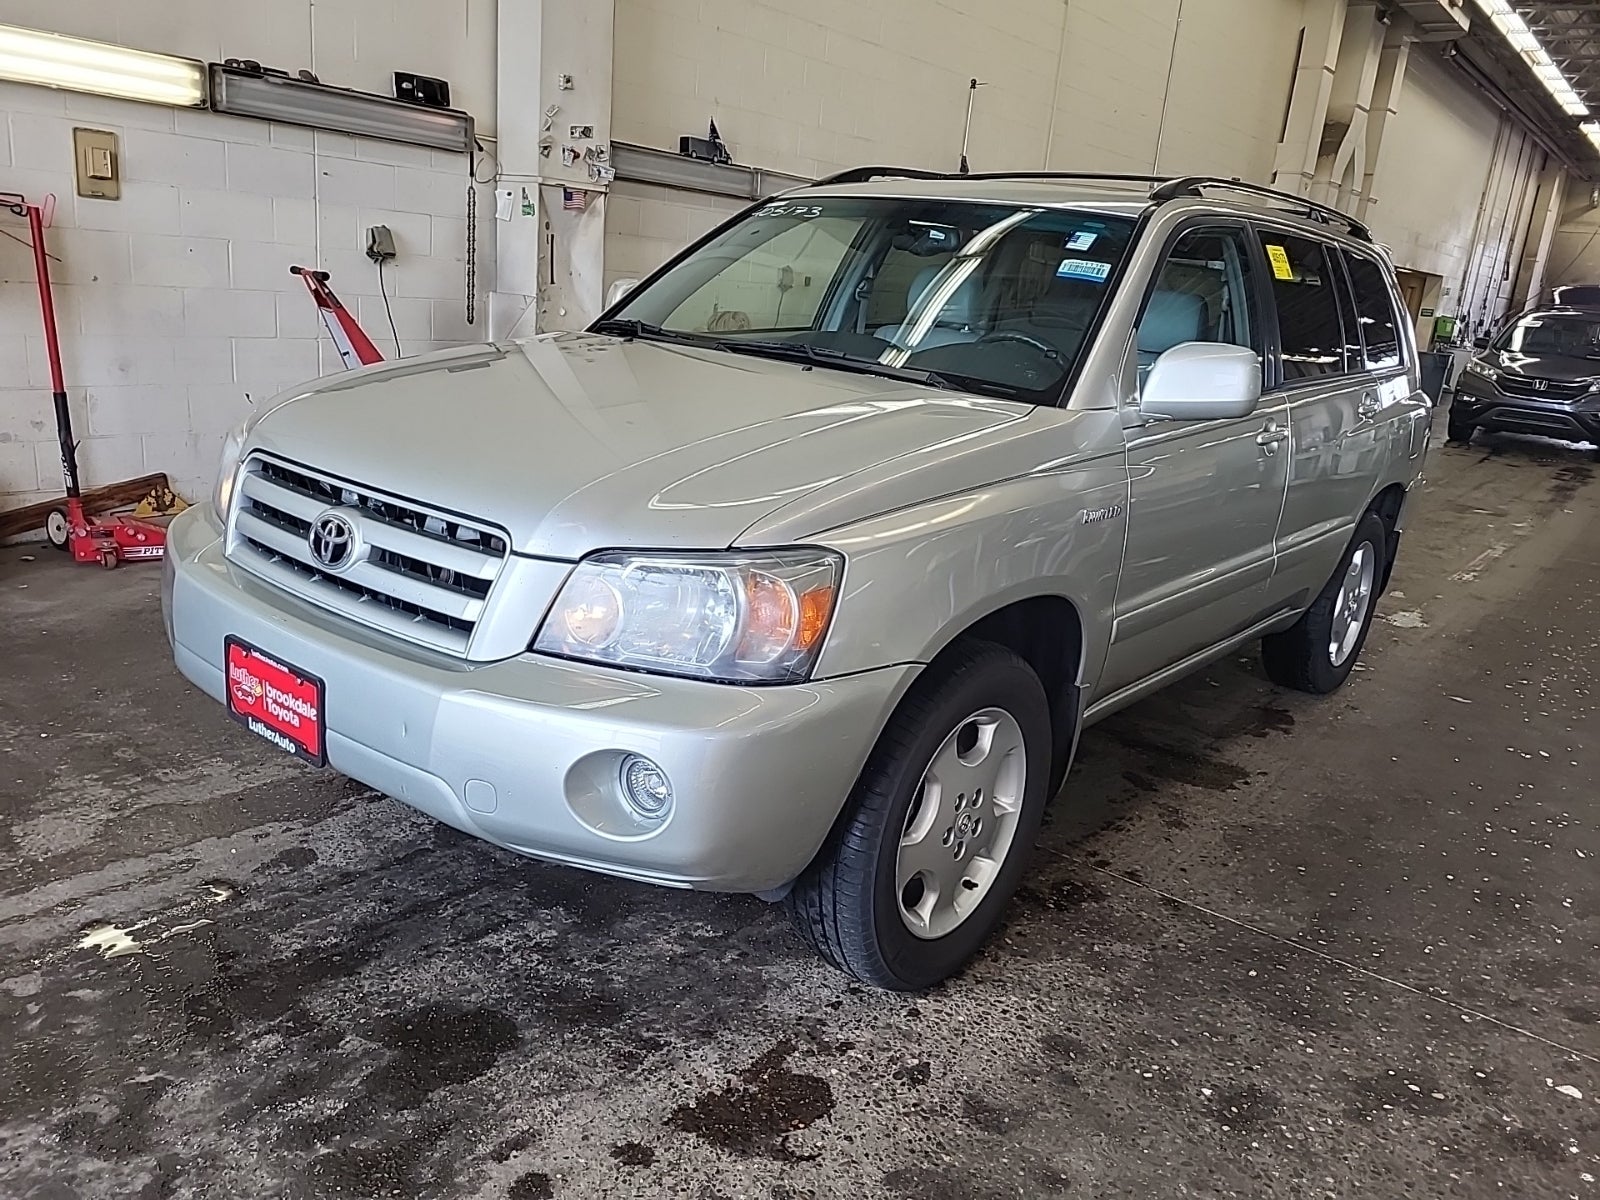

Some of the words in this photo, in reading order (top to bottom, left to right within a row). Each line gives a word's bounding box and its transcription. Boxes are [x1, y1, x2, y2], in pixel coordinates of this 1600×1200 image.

[143, 547, 165, 555] PIT
[265, 681, 317, 721] brookdale
[266, 698, 300, 728] Toyota
[248, 716, 296, 753] LutherAuto
